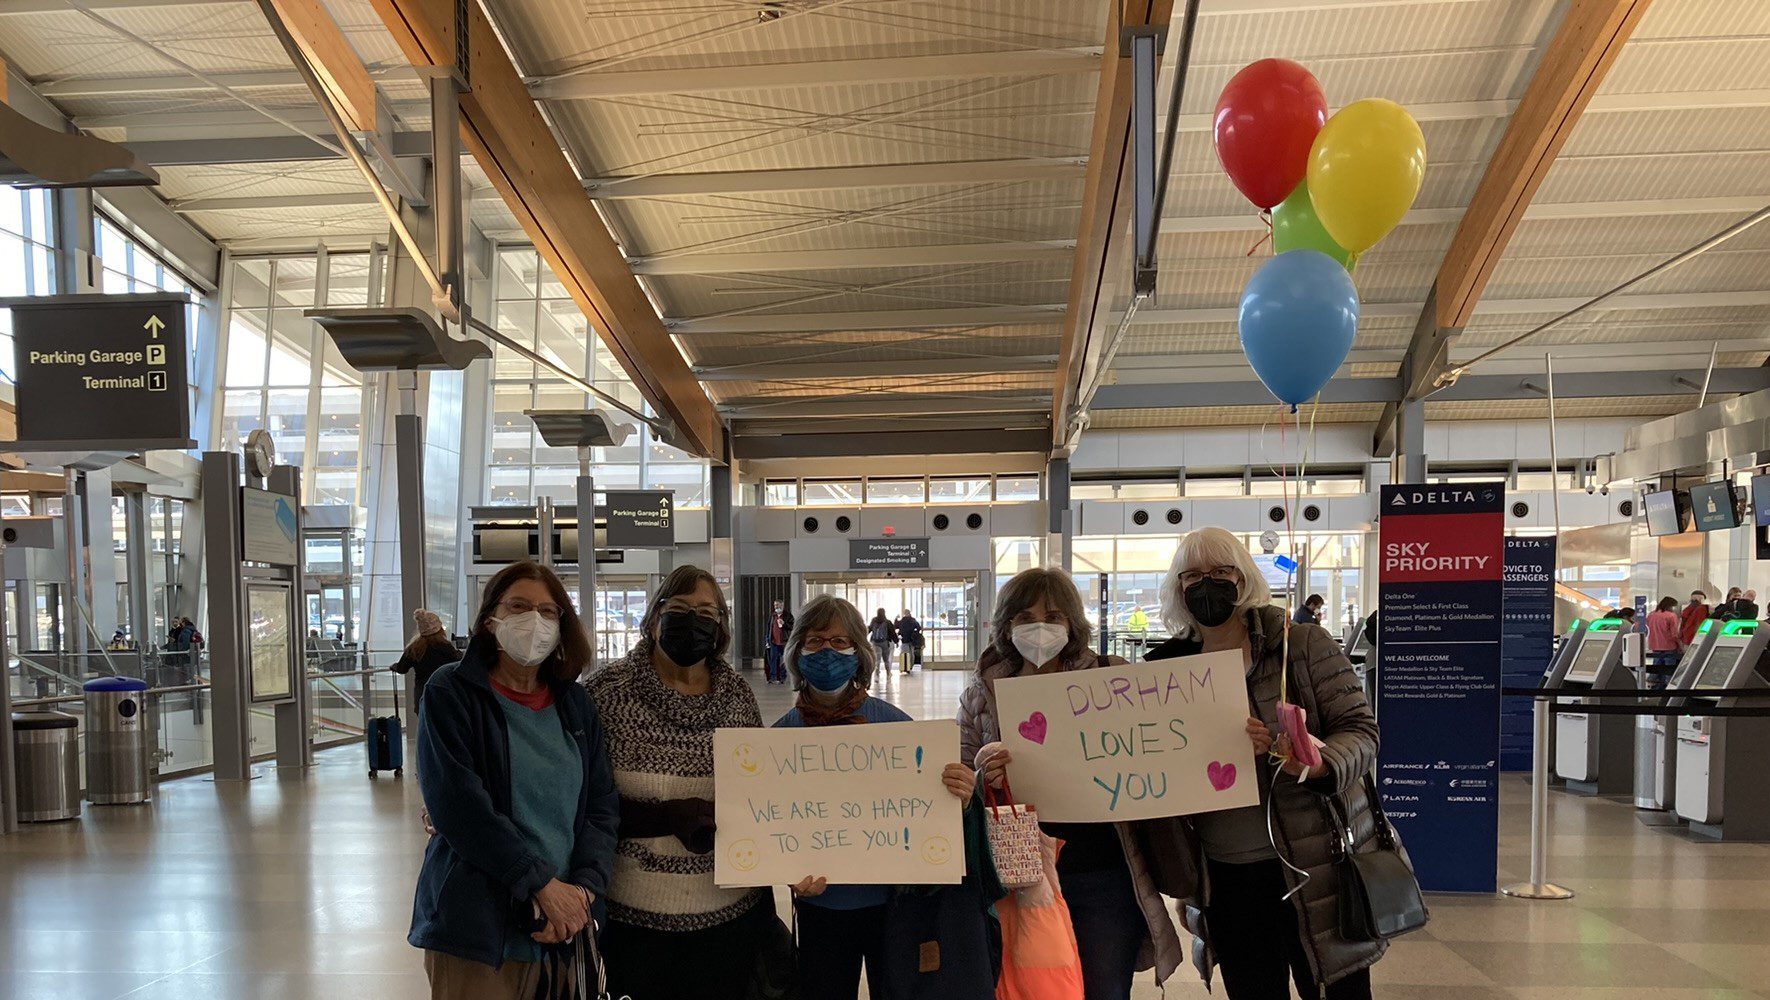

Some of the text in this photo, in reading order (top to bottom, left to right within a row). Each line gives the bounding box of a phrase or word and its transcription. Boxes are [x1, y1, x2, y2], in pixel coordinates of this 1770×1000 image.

[30, 346, 162, 366] Parking Garage P
[82, 374, 161, 388] Terminal 1
[1412, 491, 1475, 504] DELTA
[1386, 542, 1430, 556] SKY
[1386, 556, 1489, 571] PRIORITY
[1066, 667, 1216, 716] DURHAM
[1080, 718, 1188, 761] LOVES
[769, 742, 924, 776] WELCOME!
[1094, 772, 1167, 811] YOU
[748, 798, 933, 823] WE ARE SO HAPPY
[770, 826, 910, 853] TO SEE YOU!
